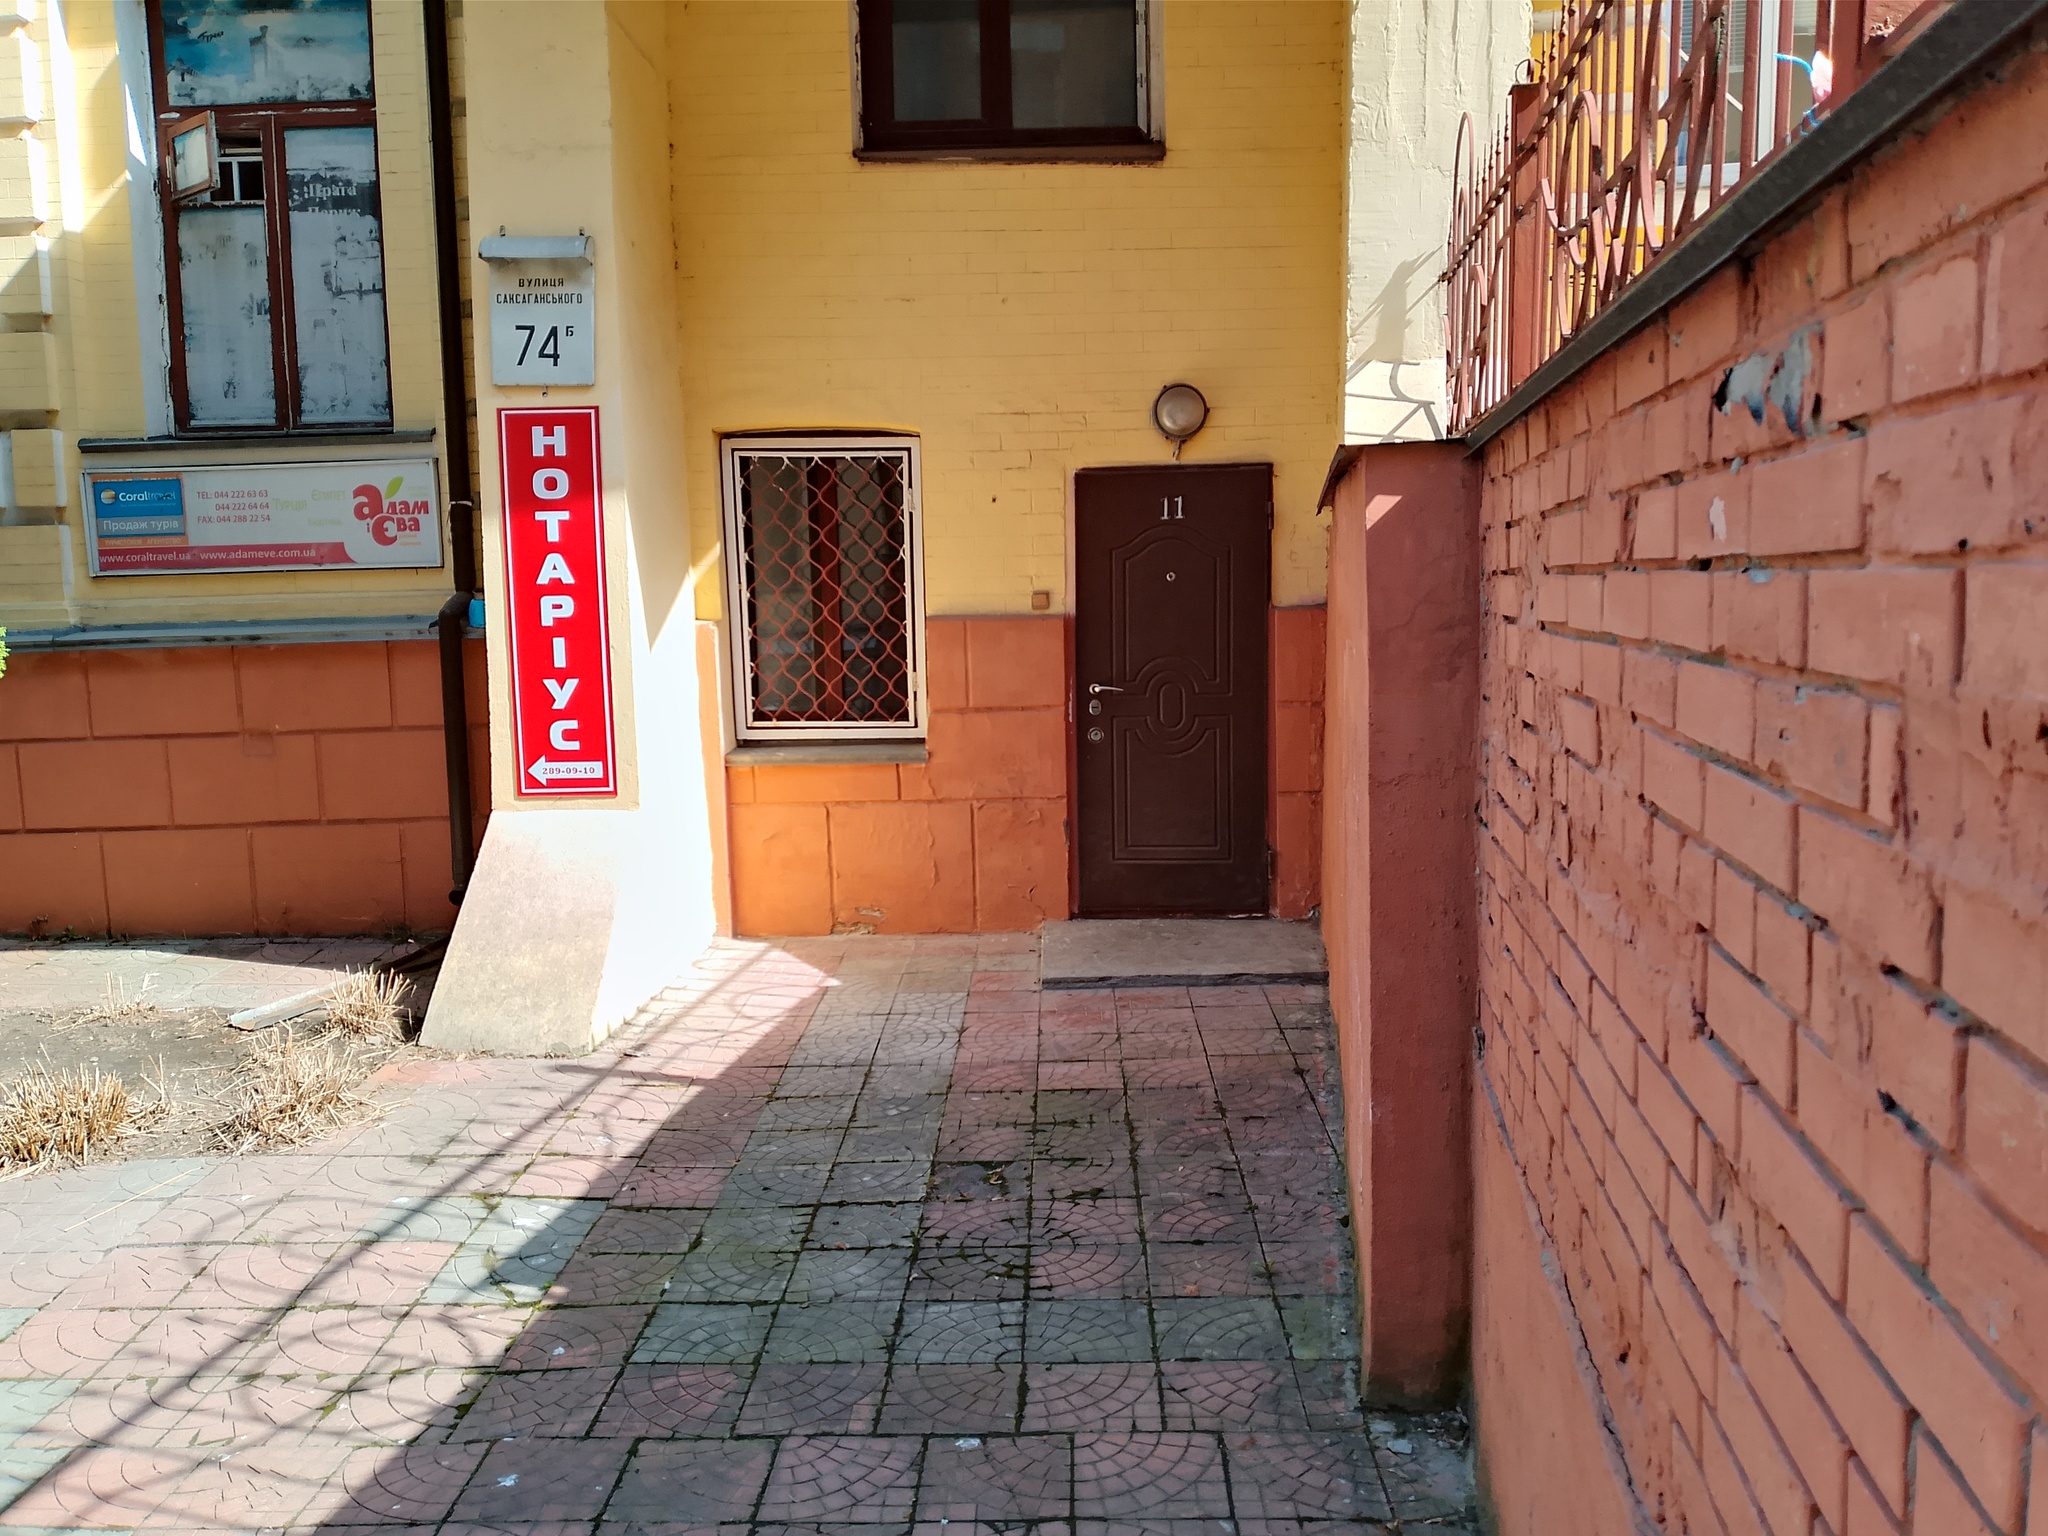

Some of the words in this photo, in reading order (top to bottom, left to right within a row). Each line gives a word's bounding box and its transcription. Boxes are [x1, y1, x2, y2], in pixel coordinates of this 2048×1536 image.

[518, 278, 564, 287] ВУЛИЦЯ
[496, 293, 583, 304] САКСАГАНСЬКОГО
[214, 490, 229, 499] 044
[231, 490, 245, 499] 222
[247, 489, 257, 498] 63
[258, 489, 268, 498] 63
[215, 503, 230, 511] 044
[232, 502, 246, 511] 222
[248, 502, 258, 510] 64
[259, 501, 270, 510] 64
[1159, 495, 1186, 520] 11
[216, 515, 231, 523] 044
[233, 514, 248, 523] 288
[249, 514, 259, 523] 22
[261, 514, 271, 522] 54
[103, 520, 148, 532] Продаж
[150, 519, 179, 531] турів
[99, 551, 191, 562] www.coraltravel.ua
[200, 549, 316, 560] www.adameve.com.ua
[531, 425, 581, 750] НОТАРІУС
[542, 767, 595, 775] 289-09-10
